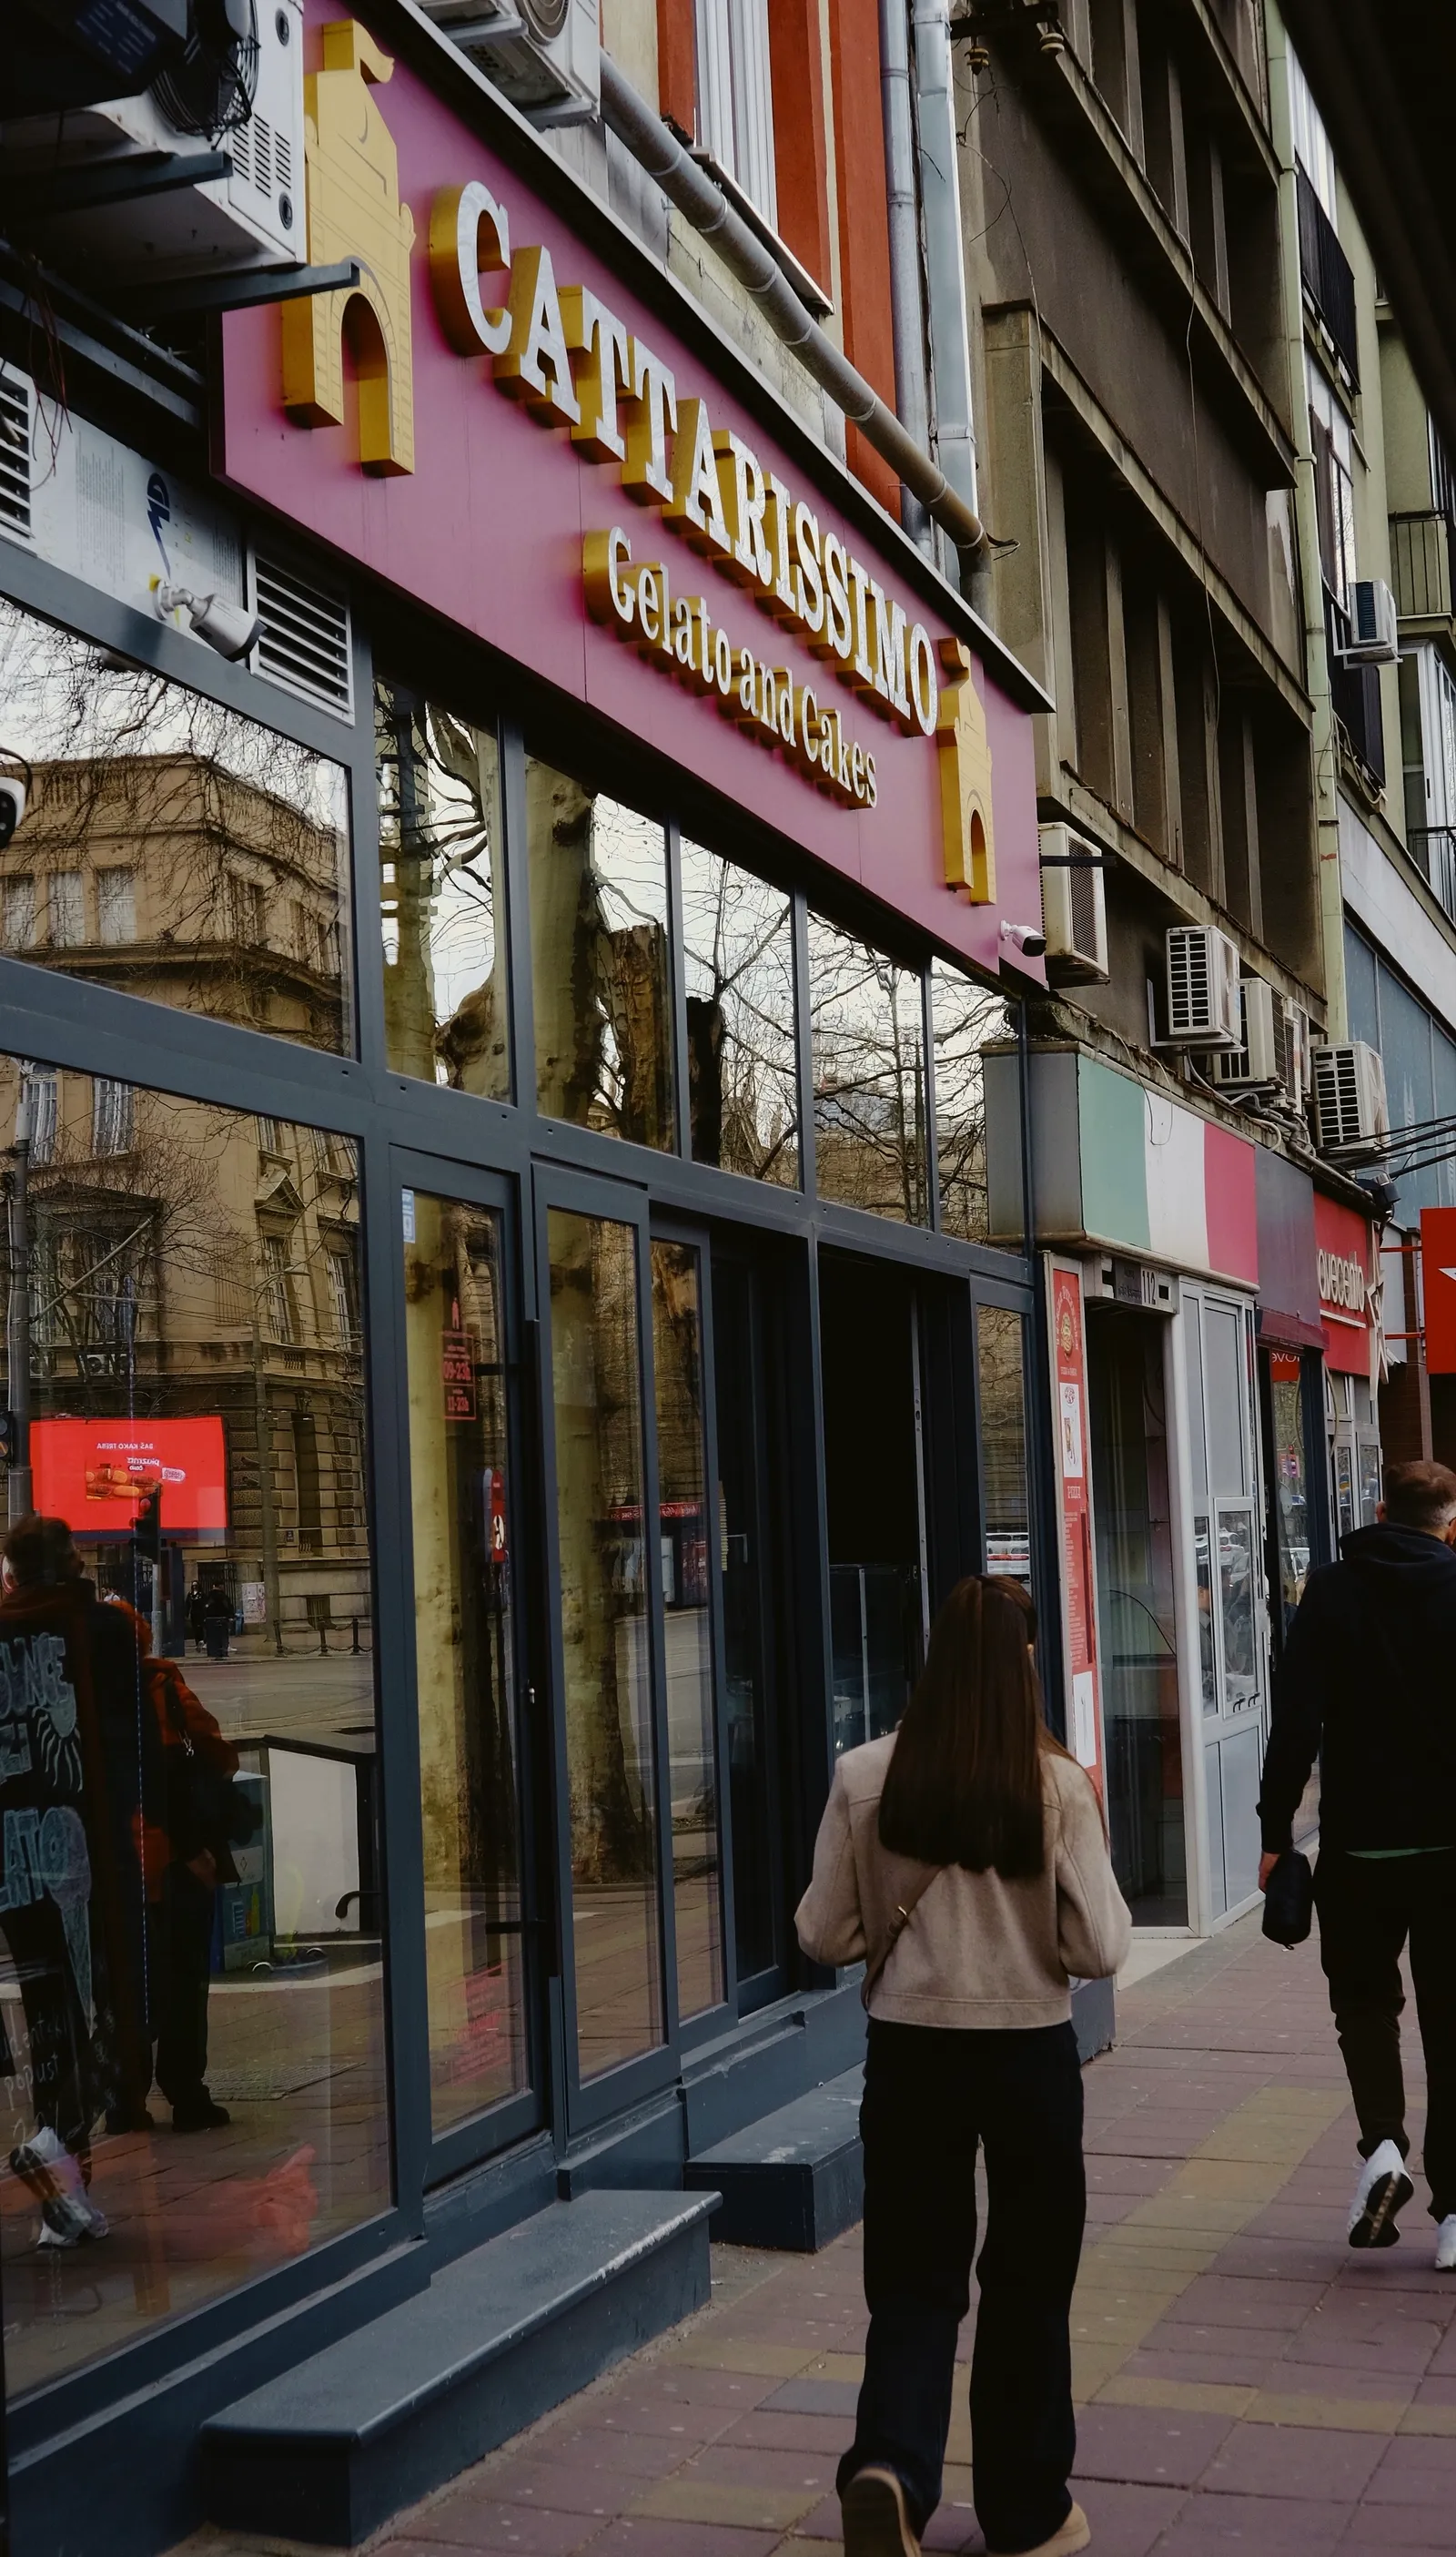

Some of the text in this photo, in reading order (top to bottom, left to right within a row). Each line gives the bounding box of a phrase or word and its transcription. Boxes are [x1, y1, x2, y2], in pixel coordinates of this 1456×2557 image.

[457, 181, 937, 736] CATTARISSIMO
[608, 526, 877, 808] Gelato and Cakes
[1142, 1270, 1156, 1305] 112
[1317, 1248, 1365, 1313] ovecento
